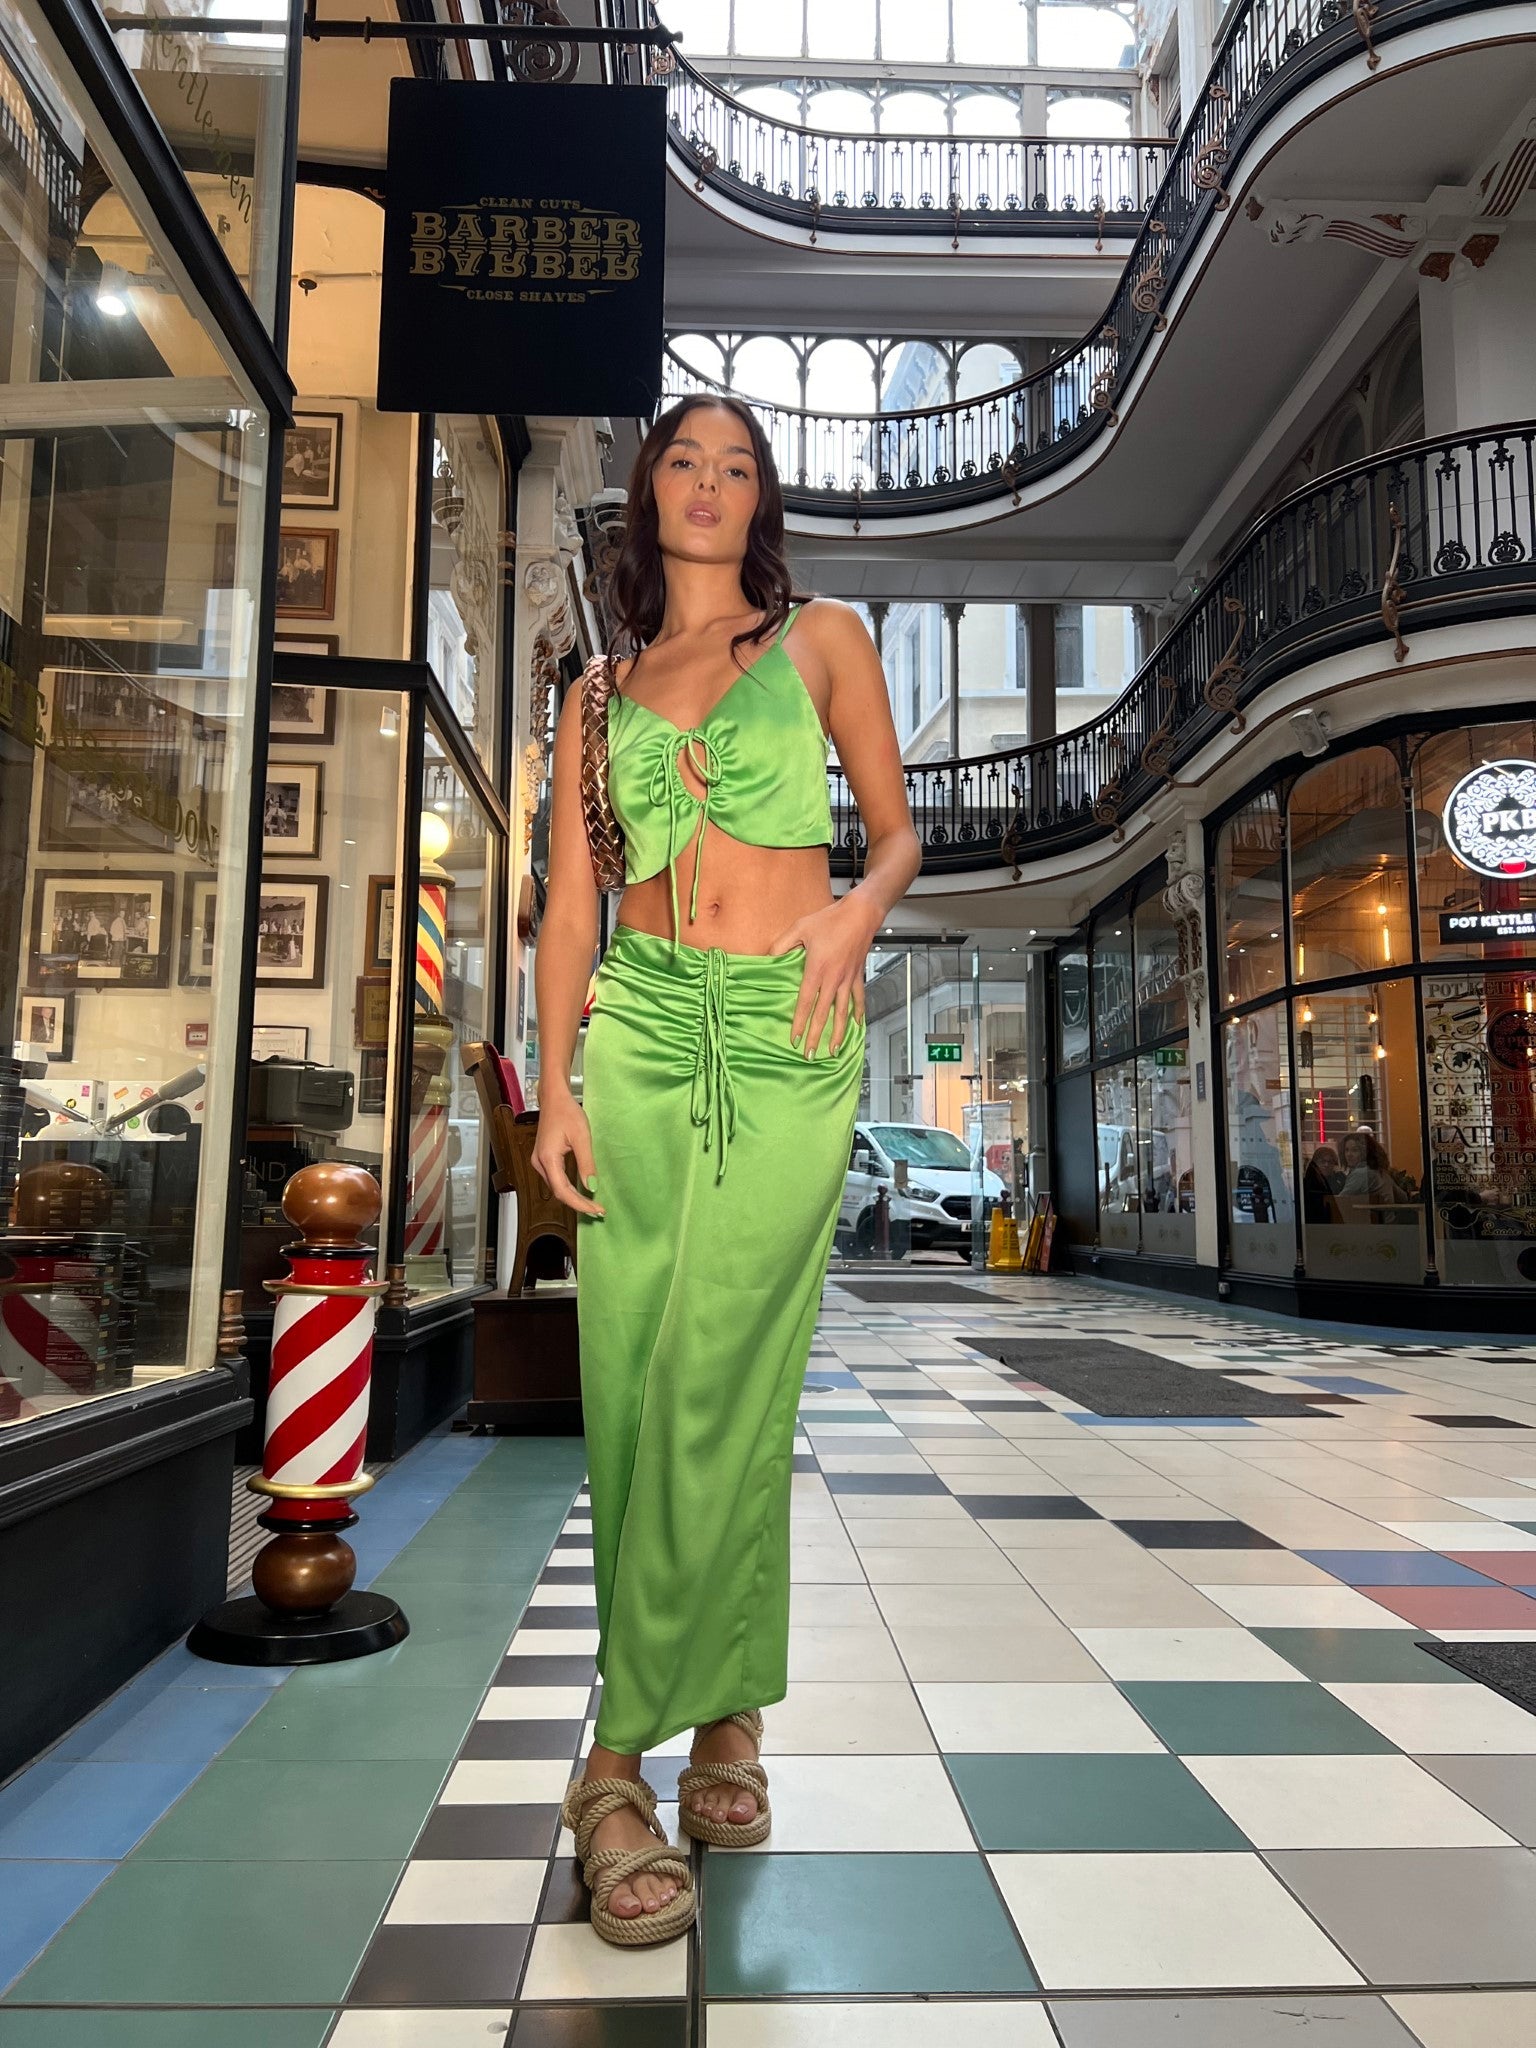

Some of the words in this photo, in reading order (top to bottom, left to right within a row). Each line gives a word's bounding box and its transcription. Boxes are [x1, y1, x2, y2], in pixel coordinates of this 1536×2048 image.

[479, 197, 533, 209] CLEAN
[540, 199, 581, 210] CUTS
[410, 211, 643, 249] BARBER
[466, 290, 514, 301] CLOSE
[519, 291, 586, 303] SHAVES
[1449, 917, 1478, 929] POT
[1481, 913, 1533, 927] KETTLE
[1496, 926, 1516, 935] EST.
[1428, 982, 1463, 997] POT
[1435, 1125, 1519, 1148] LATTE
[1438, 1152, 1482, 1165] HOT
[1437, 1174, 1512, 1184] BLENDED
